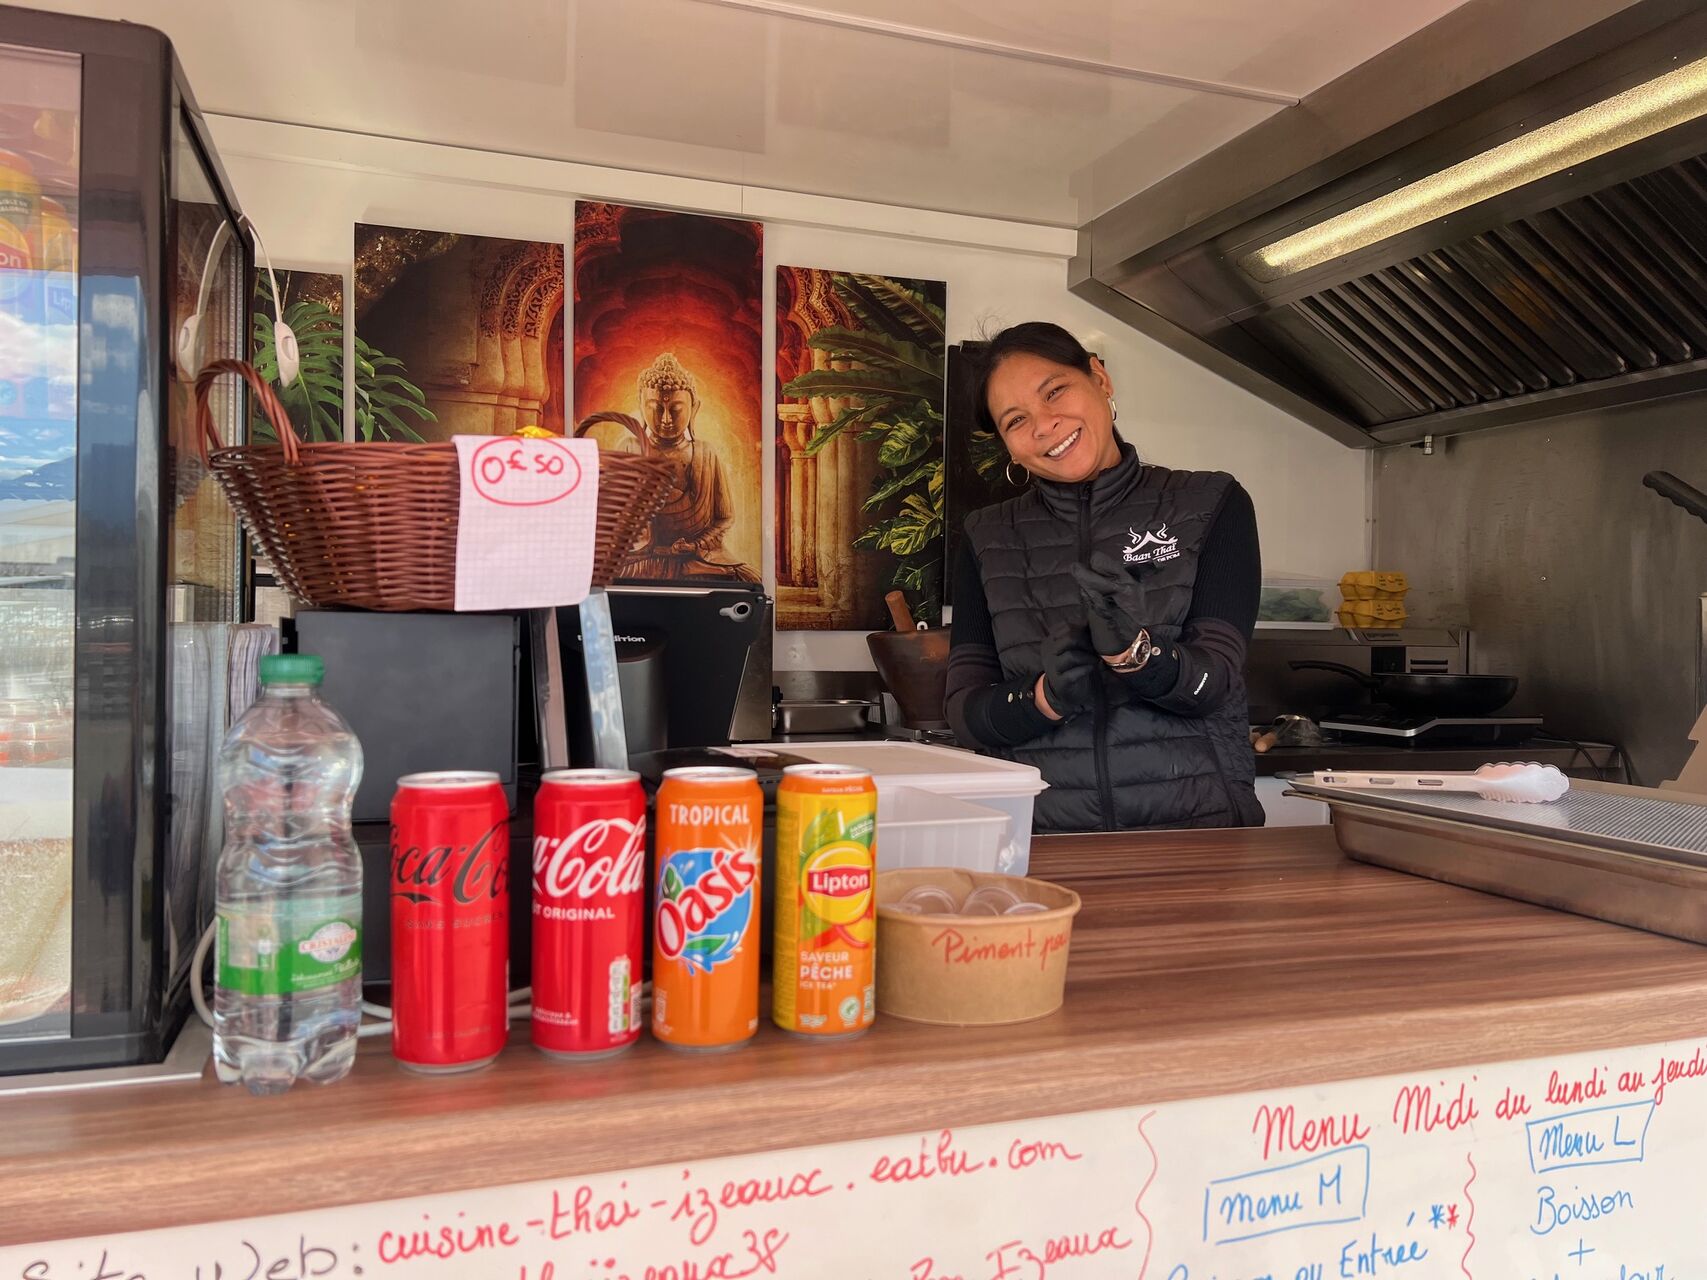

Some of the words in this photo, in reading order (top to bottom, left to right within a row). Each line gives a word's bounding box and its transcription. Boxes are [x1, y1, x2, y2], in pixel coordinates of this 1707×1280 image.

[1123, 553, 1151, 562] Baan
[670, 803, 749, 825] TROPICAL
[812, 871, 869, 894] Lipton
[542, 906, 615, 921] ORIGINAL
[657, 850, 756, 958] Oasis
[801, 952, 849, 963] SAVEUR
[932, 929, 1035, 964] Piment
[801, 963, 853, 980] PÊCHE
[1252, 1104, 1371, 1160] Menu
[1393, 1075, 1479, 1134] Midi
[1495, 1087, 1532, 1120] du
[1545, 1066, 1608, 1106] lundi
[1617, 1071, 1645, 1092] au
[1539, 1122, 1605, 1161] Menu
[1613, 1115, 1637, 1145] L
[1319, 1164, 1342, 1205] M
[1530, 1185, 1634, 1236] Boisson
